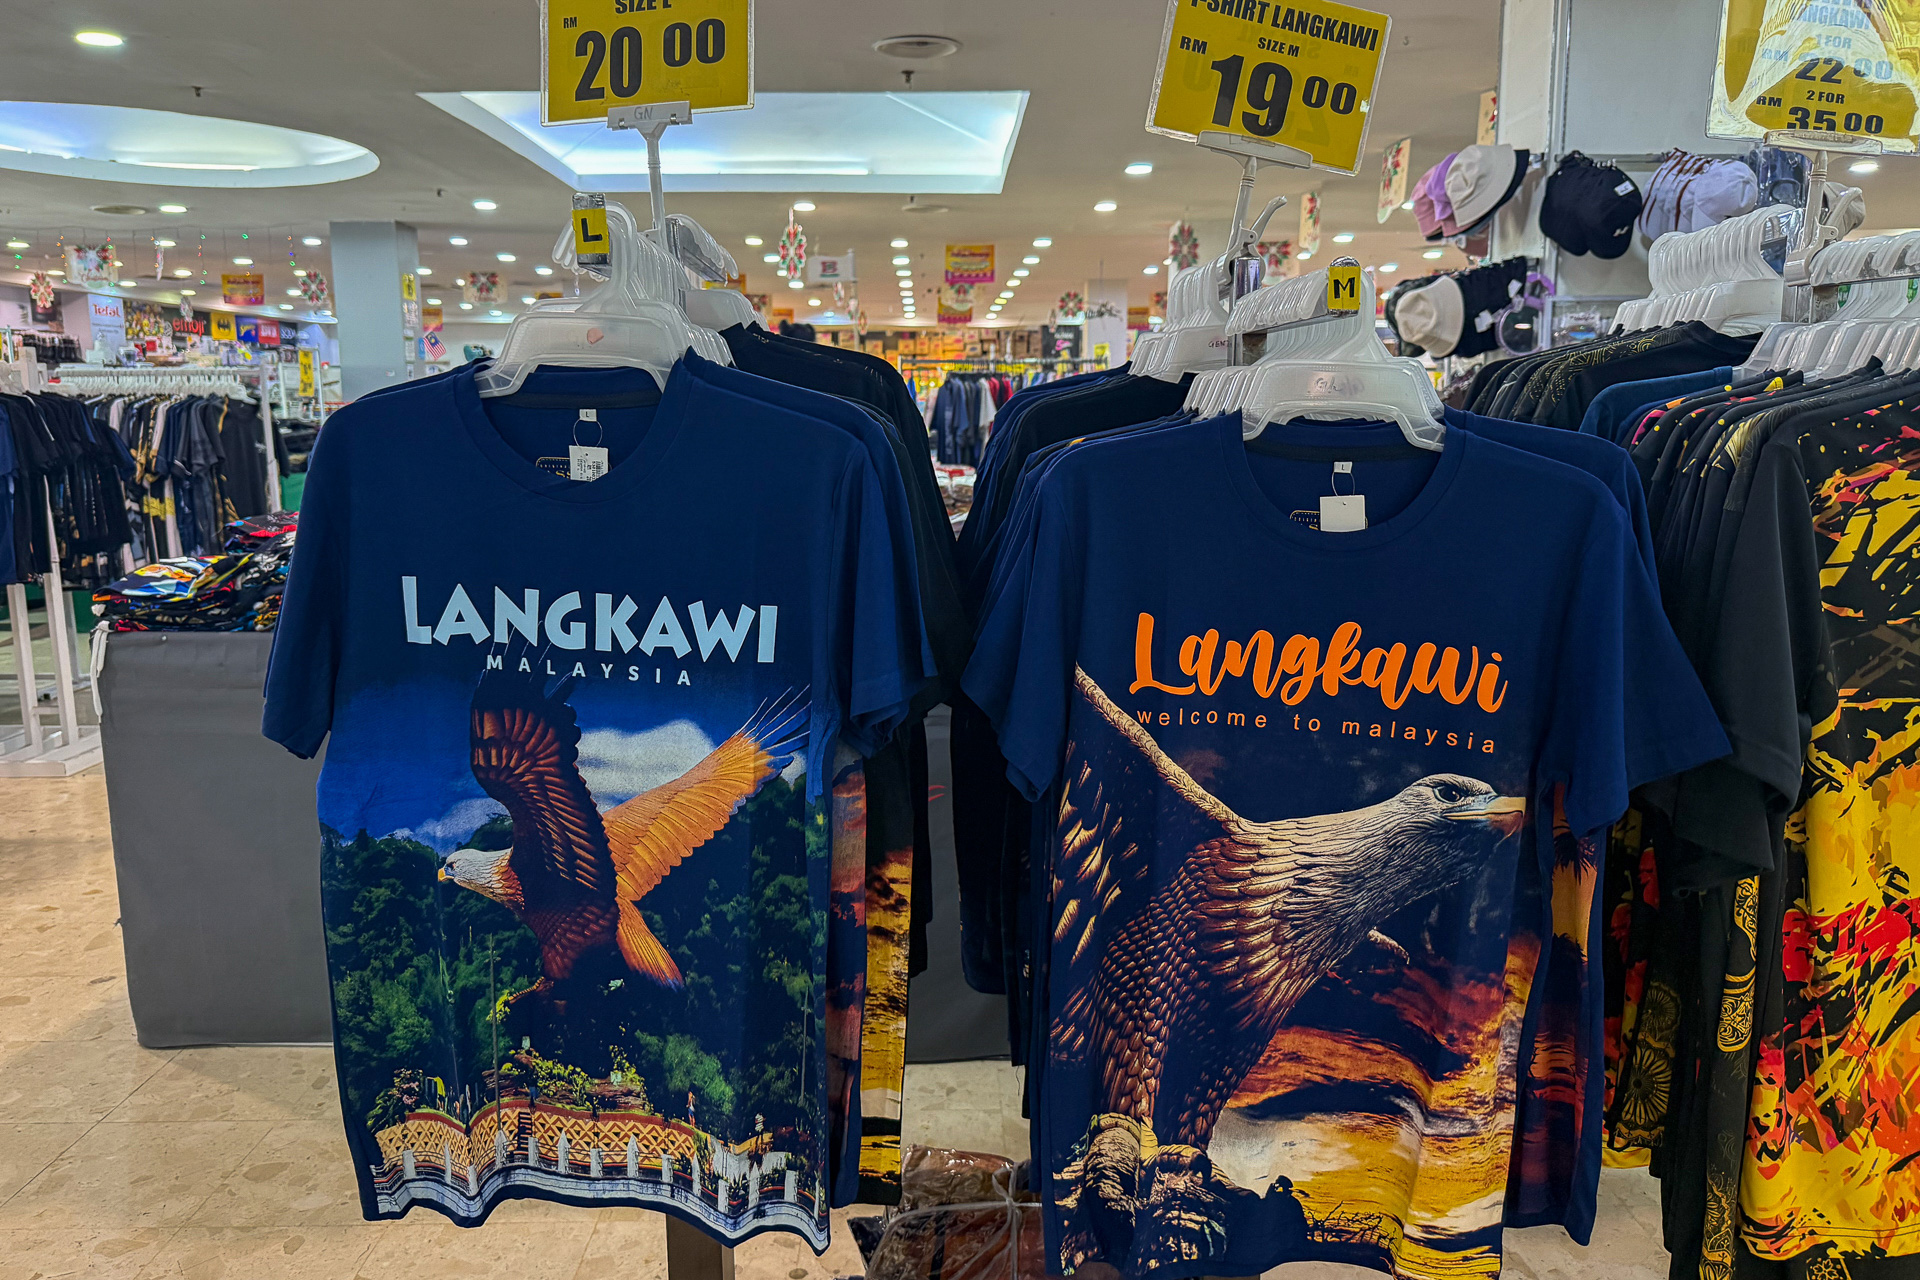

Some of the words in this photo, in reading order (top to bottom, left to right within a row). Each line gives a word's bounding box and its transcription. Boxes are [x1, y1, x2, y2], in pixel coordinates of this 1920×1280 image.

[615, 0, 657, 14] SIZE
[563, 17, 577, 29] RM
[1271, 4, 1379, 51] LANGKAWI
[1180, 36, 1208, 55] RM
[1257, 37, 1285, 54] SIZE
[1288, 46, 1300, 57] M
[1825, 35, 1852, 49] FOR
[575, 26, 643, 102] 20
[663, 18, 726, 68] 00
[1795, 52, 1845, 84] 22
[1853, 57, 1893, 80] 00
[1210, 54, 1293, 137] 19
[1302, 75, 1357, 115] 00
[1756, 95, 1782, 107] RM
[1806, 90, 1816, 101] 2
[1818, 91, 1845, 105] FOR
[1786, 106, 1837, 131] 35
[1843, 112, 1884, 134] 00
[581, 218, 603, 242] L
[1333, 277, 1355, 298] M
[92, 303, 121, 318] Tefal
[172, 317, 205, 337] emoji
[402, 576, 778, 663] LANGKAWI
[486, 655, 691, 686] MALAYSIA
[1129, 612, 1508, 713] Langkawi
[1137, 708, 1267, 729] welcome
[1294, 713, 1321, 732] to
[1342, 719, 1495, 754] malaysia
